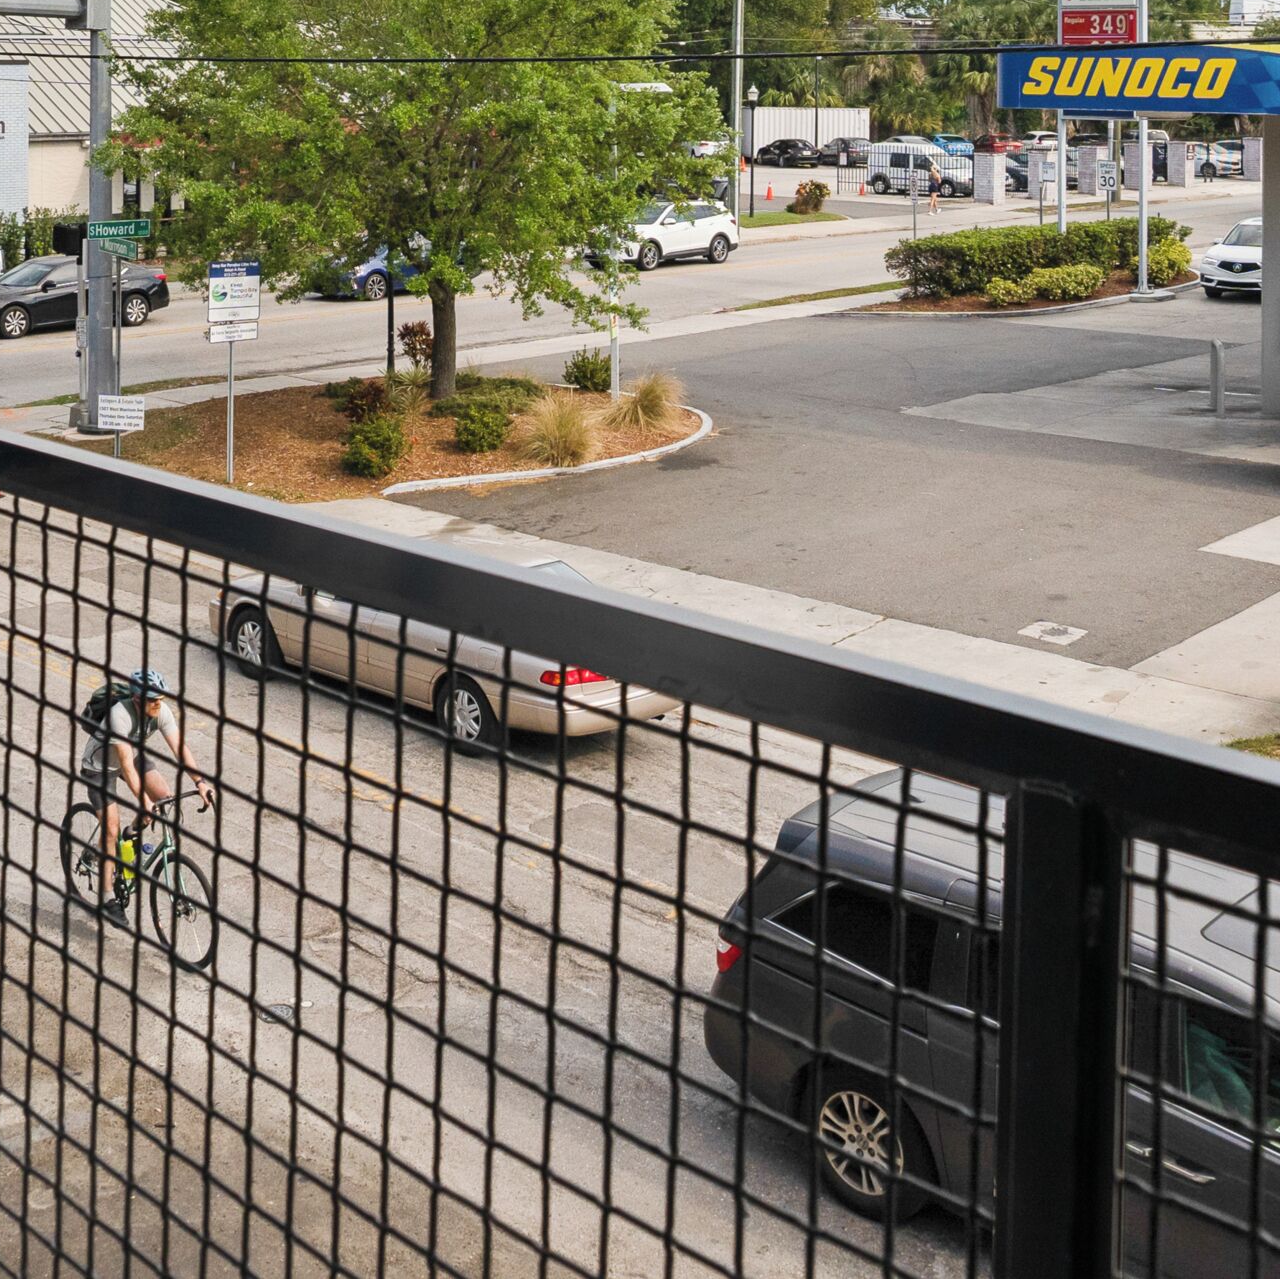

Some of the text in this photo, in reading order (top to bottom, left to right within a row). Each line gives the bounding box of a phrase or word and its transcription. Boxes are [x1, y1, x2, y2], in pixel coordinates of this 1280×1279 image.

[1090, 14, 1126, 35] 349
[1022, 56, 1237, 100] SUNOCO
[1100, 176, 1116, 187] 30
[95, 223, 135, 236] Howard
